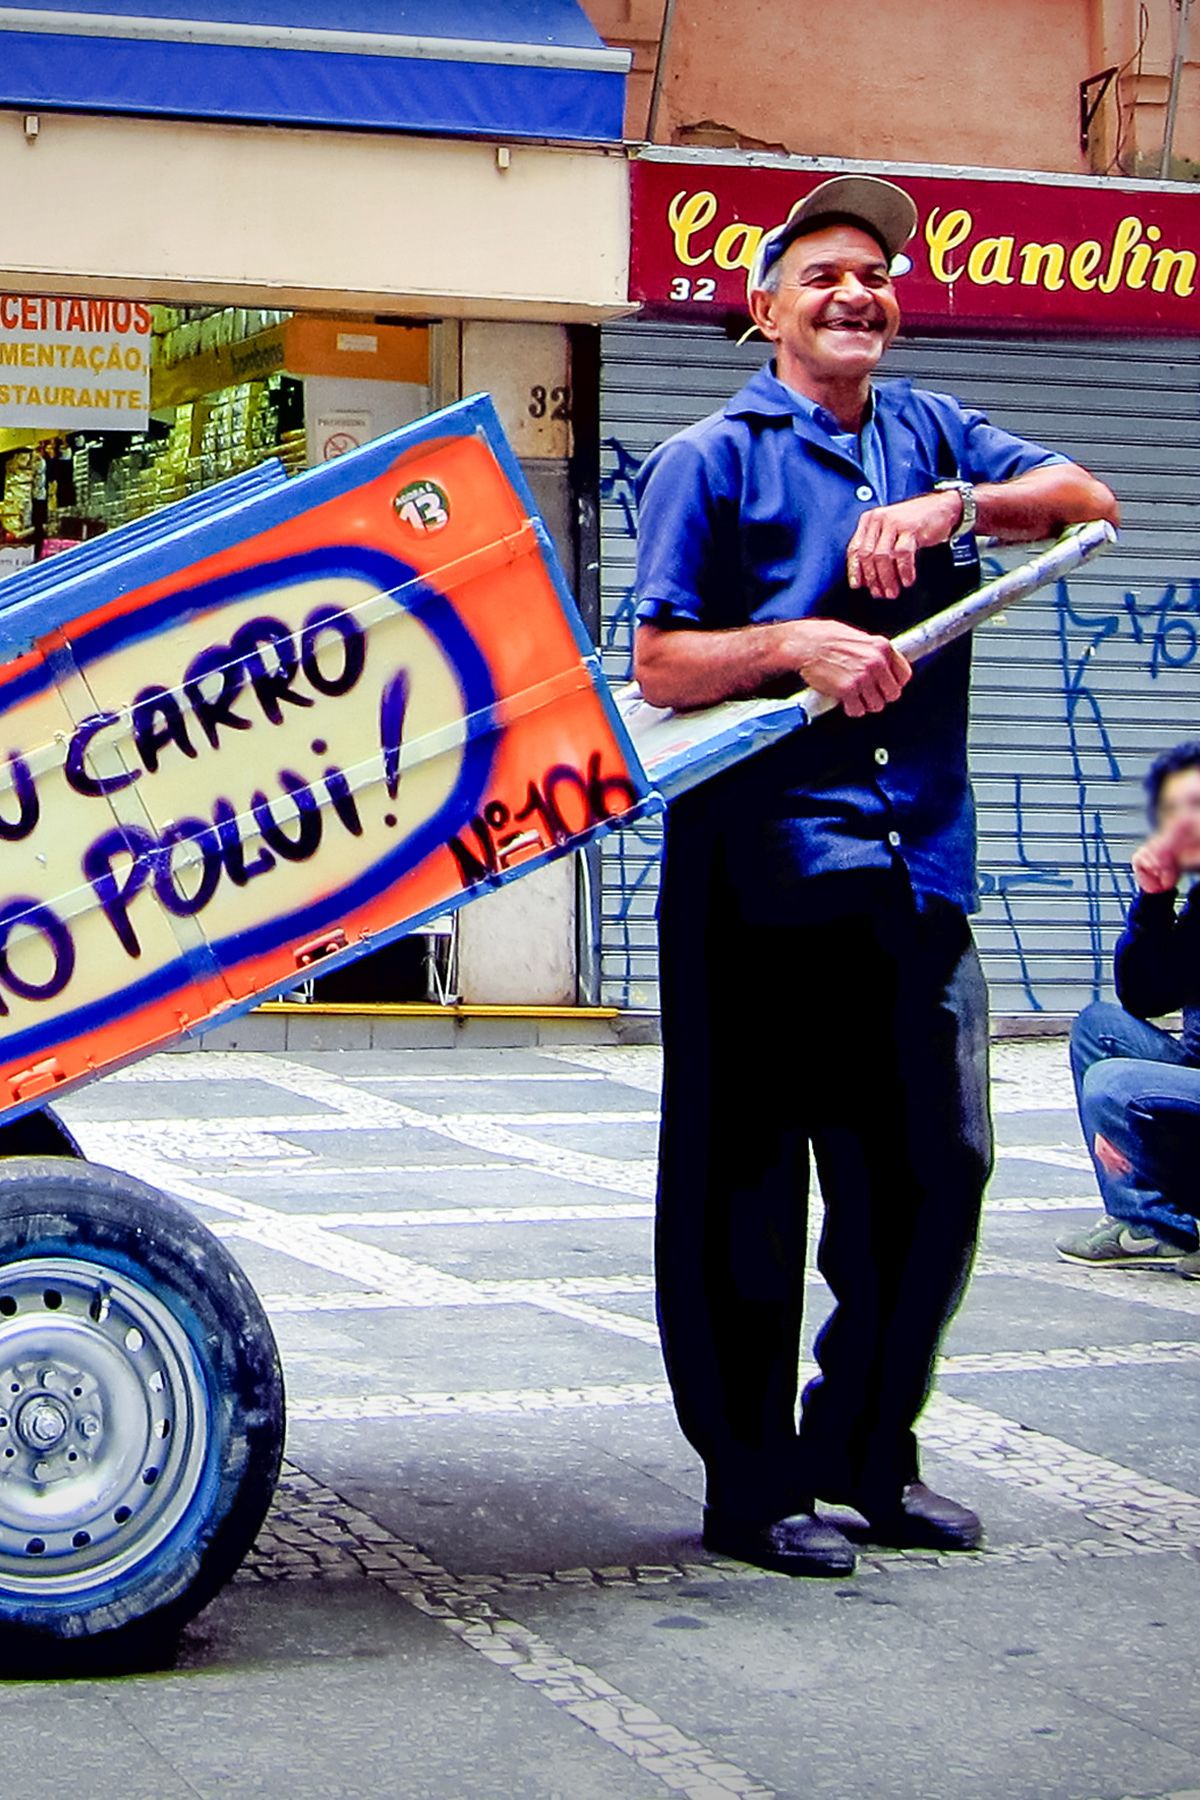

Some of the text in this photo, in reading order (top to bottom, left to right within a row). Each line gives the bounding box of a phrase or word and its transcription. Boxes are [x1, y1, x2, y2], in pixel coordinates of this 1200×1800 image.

[668, 190, 763, 271] Ca
[669, 277, 716, 302] 32
[529, 385, 570, 421] 32
[399, 492, 449, 532] 13
[64, 603, 368, 798] CARRO
